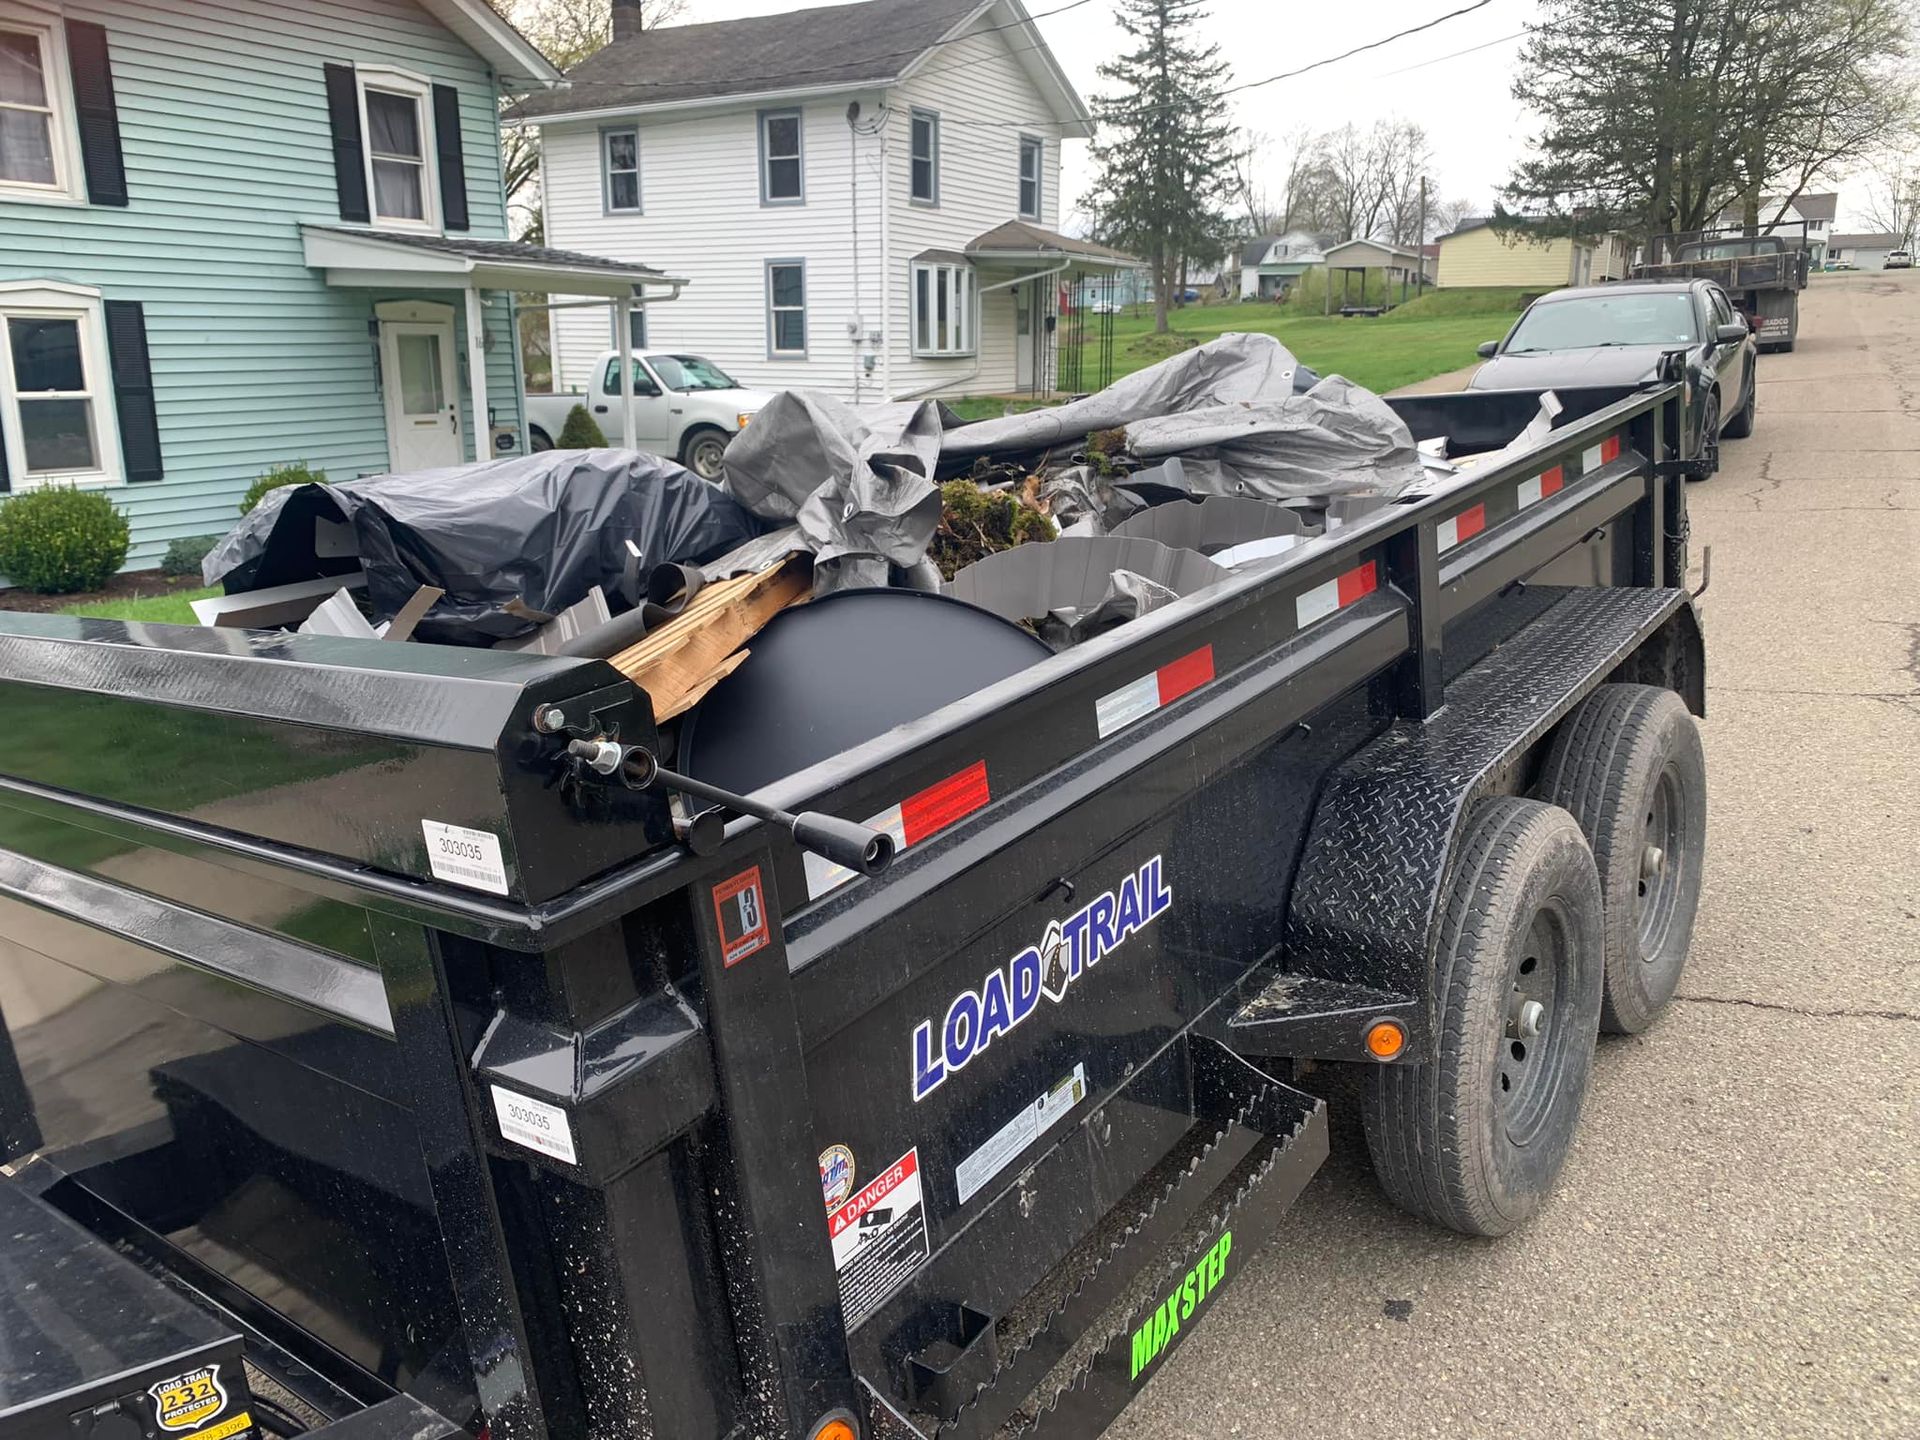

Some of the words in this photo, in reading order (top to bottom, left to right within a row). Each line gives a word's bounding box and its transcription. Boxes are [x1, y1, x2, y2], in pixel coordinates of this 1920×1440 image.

[439, 837, 482, 861] 303035
[744, 886, 758, 928] 3
[914, 946, 1043, 1102] LOAD
[1061, 855, 1171, 982] TRAIL
[508, 1103, 551, 1130] 303035
[847, 1165, 904, 1220] DANGER
[157, 1380, 182, 1395] LOAD
[183, 1370, 211, 1386] TRAIL
[164, 1396, 218, 1420] PROTECTED
